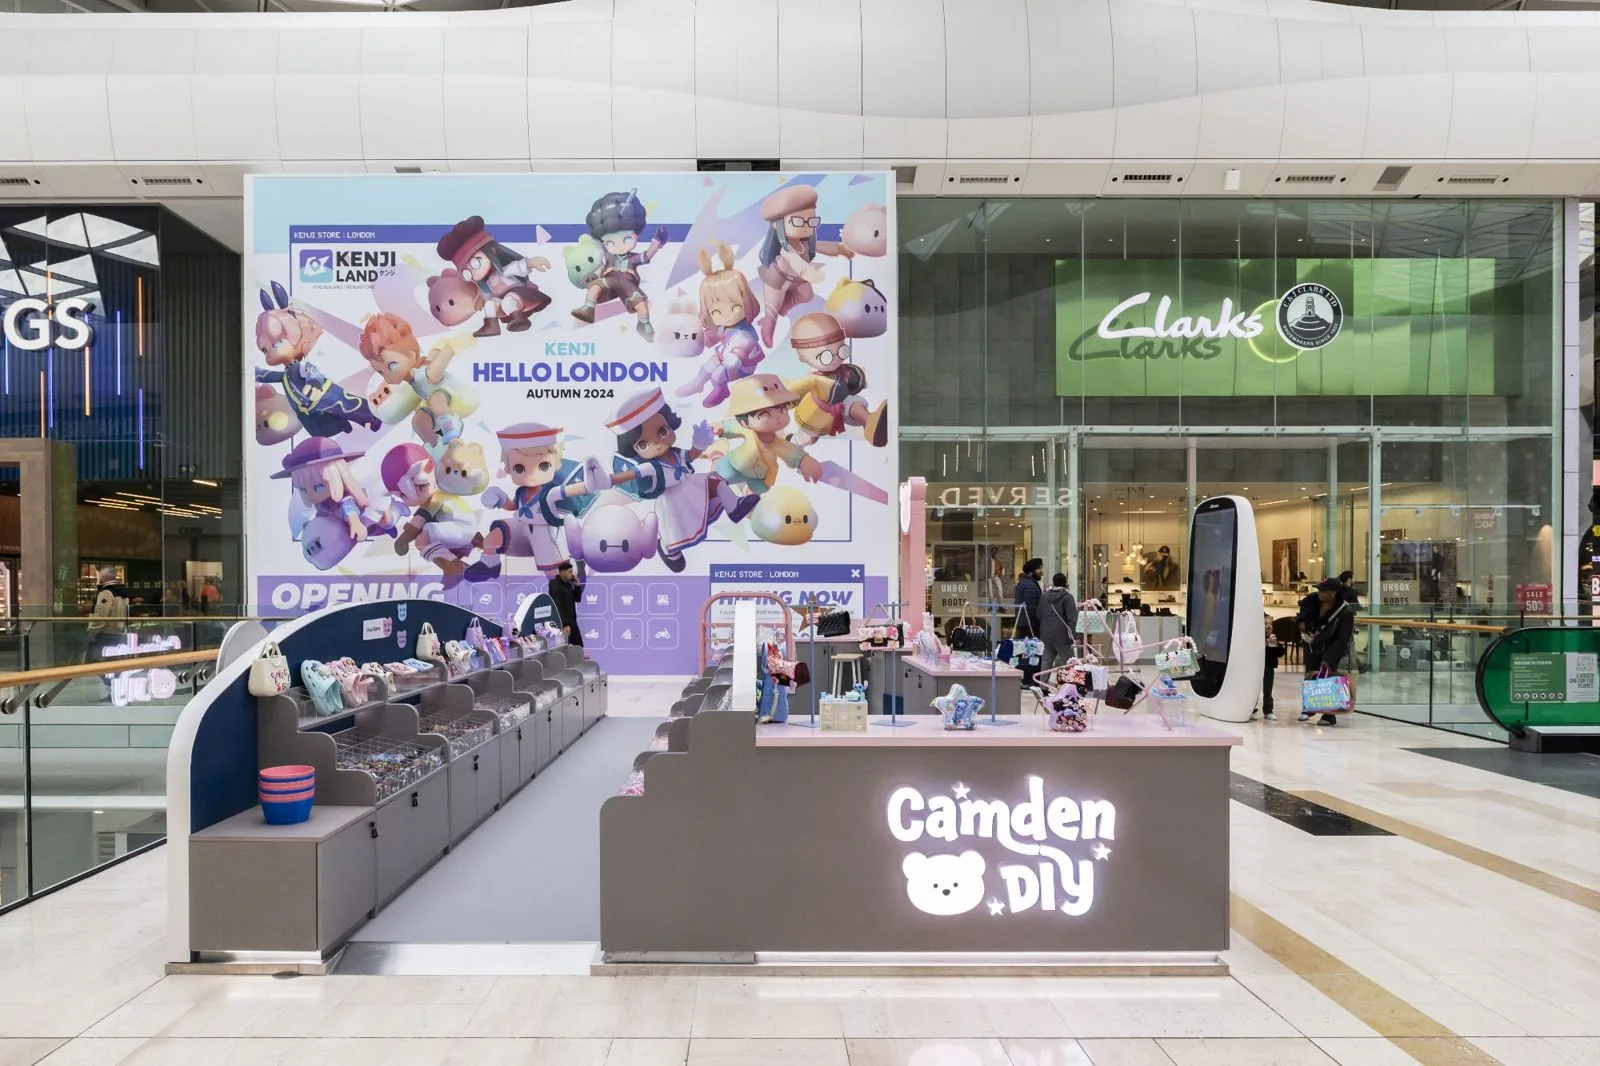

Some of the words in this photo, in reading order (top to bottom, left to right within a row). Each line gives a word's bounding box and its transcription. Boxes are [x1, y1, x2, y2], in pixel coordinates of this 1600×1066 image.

[293, 231, 315, 239] KENJI
[317, 231, 341, 239] STORE
[346, 231, 376, 239] LONDON
[336, 251, 396, 267] KENJI
[336, 270, 379, 283] LAND
[1297, 285, 1324, 296] CLARK
[1325, 292, 1338, 307] LTD
[1098, 292, 1264, 339] Clarks
[3, 298, 92, 350] GS
[544, 342, 596, 356] KENJI
[473, 362, 552, 382] HELLO
[556, 361, 668, 382] LONDON
[526, 389, 581, 399] AUTUMN
[584, 388, 615, 399] 2024
[714, 570, 737, 578] KENJI
[739, 570, 763, 578] STORE
[769, 570, 799, 578] LONDON
[941, 584, 968, 592] UNBOX
[1383, 583, 1410, 592] UNBOX
[271, 582, 445, 610] OPENING
[799, 591, 854, 606] NOW
[942, 598, 967, 607] BOOTS
[1384, 597, 1409, 606] BOOTS
[887, 776, 1115, 852] Camden
